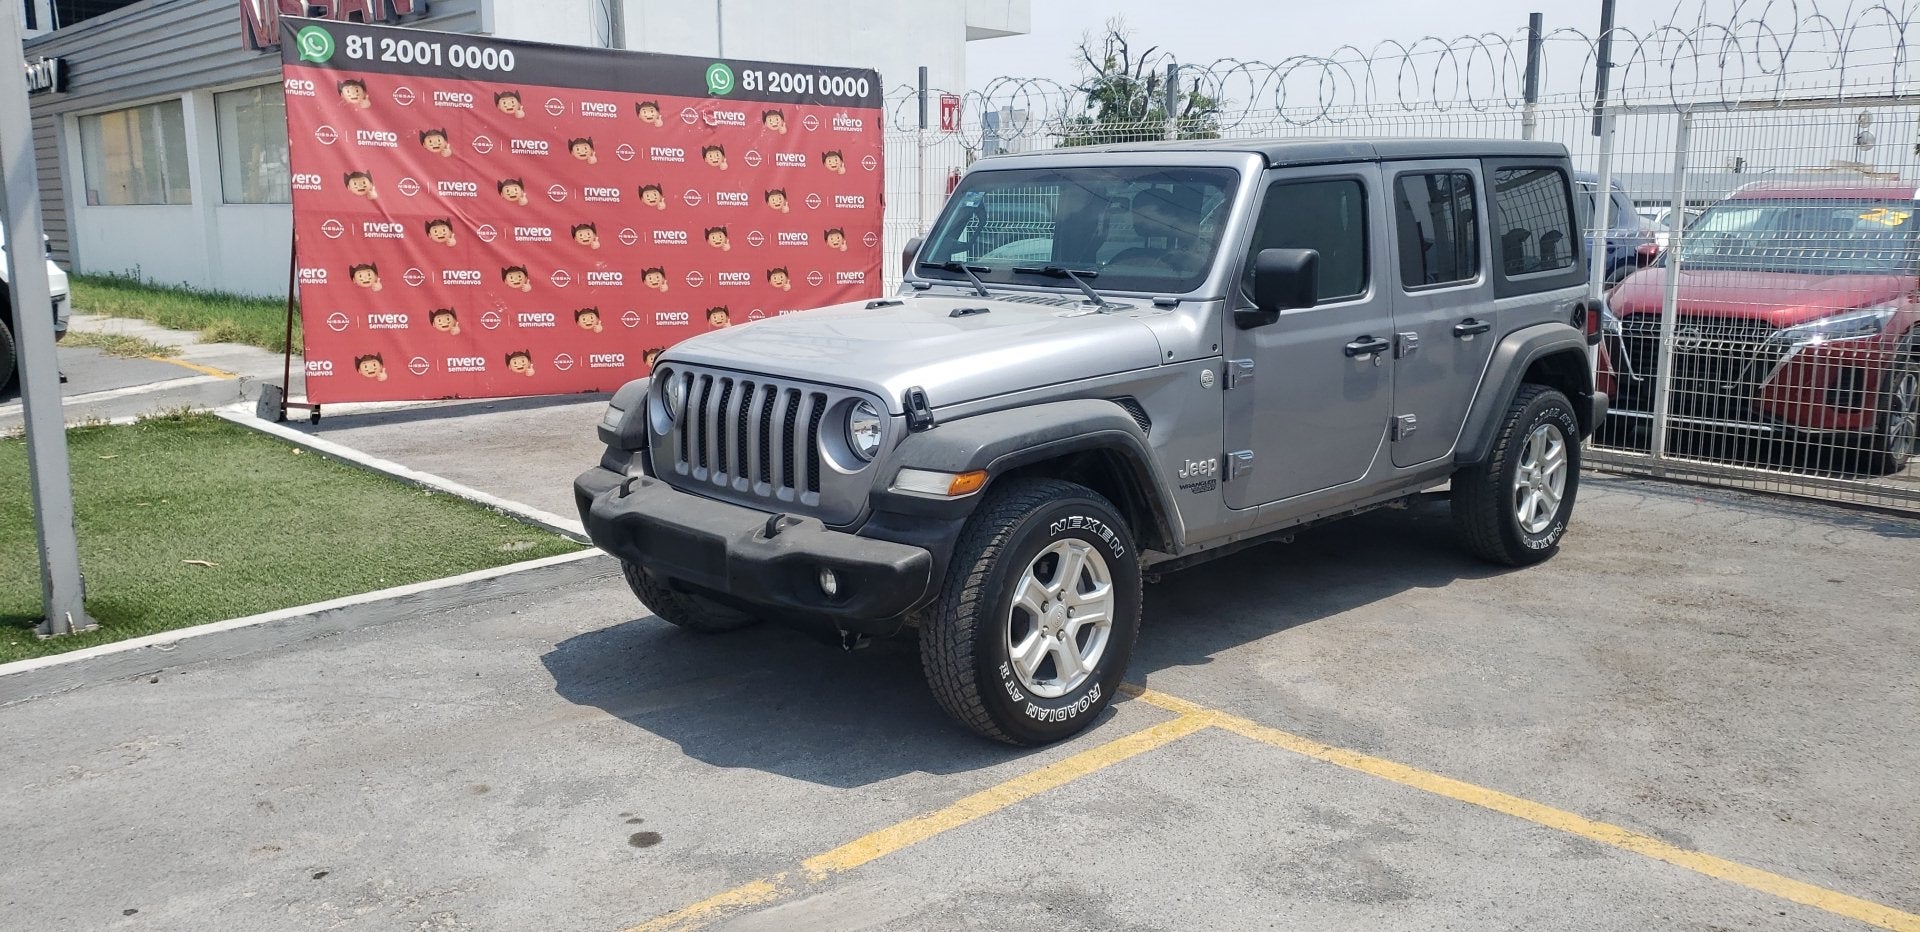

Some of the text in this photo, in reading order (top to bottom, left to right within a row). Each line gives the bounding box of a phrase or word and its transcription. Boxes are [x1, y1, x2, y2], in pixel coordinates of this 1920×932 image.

[346, 35, 515, 72] 81 2001 0000
[742, 70, 869, 98] 81 2001 0000
[434, 92, 473, 102] rivero
[582, 102, 616, 112] rivero
[714, 111, 746, 120] rivero
[833, 117, 862, 127] rivero
[357, 131, 396, 142] rivero
[512, 140, 548, 150] rivero
[651, 148, 684, 156] rivero
[776, 154, 805, 162] rivero
[438, 182, 476, 191] rivero
[585, 188, 619, 196] rivero
[717, 192, 748, 201] rivero
[835, 196, 864, 204] rivero
[364, 223, 403, 233] rivero
[515, 228, 551, 236] rivero
[654, 231, 686, 239] rivero
[443, 271, 480, 279] rivero
[588, 272, 622, 280] rivero
[368, 314, 408, 323] rivero
[518, 313, 554, 322] rivero
[656, 312, 688, 320] rivero
[448, 357, 485, 366] rivero
[590, 354, 624, 362] rivero
[1178, 458, 1217, 478] Jeep
[1179, 479, 1216, 490] WRANGLER
[1050, 516, 1125, 558] NEXEN
[1005, 680, 1024, 702] AT
[1026, 682, 1101, 722] ROADIAN
